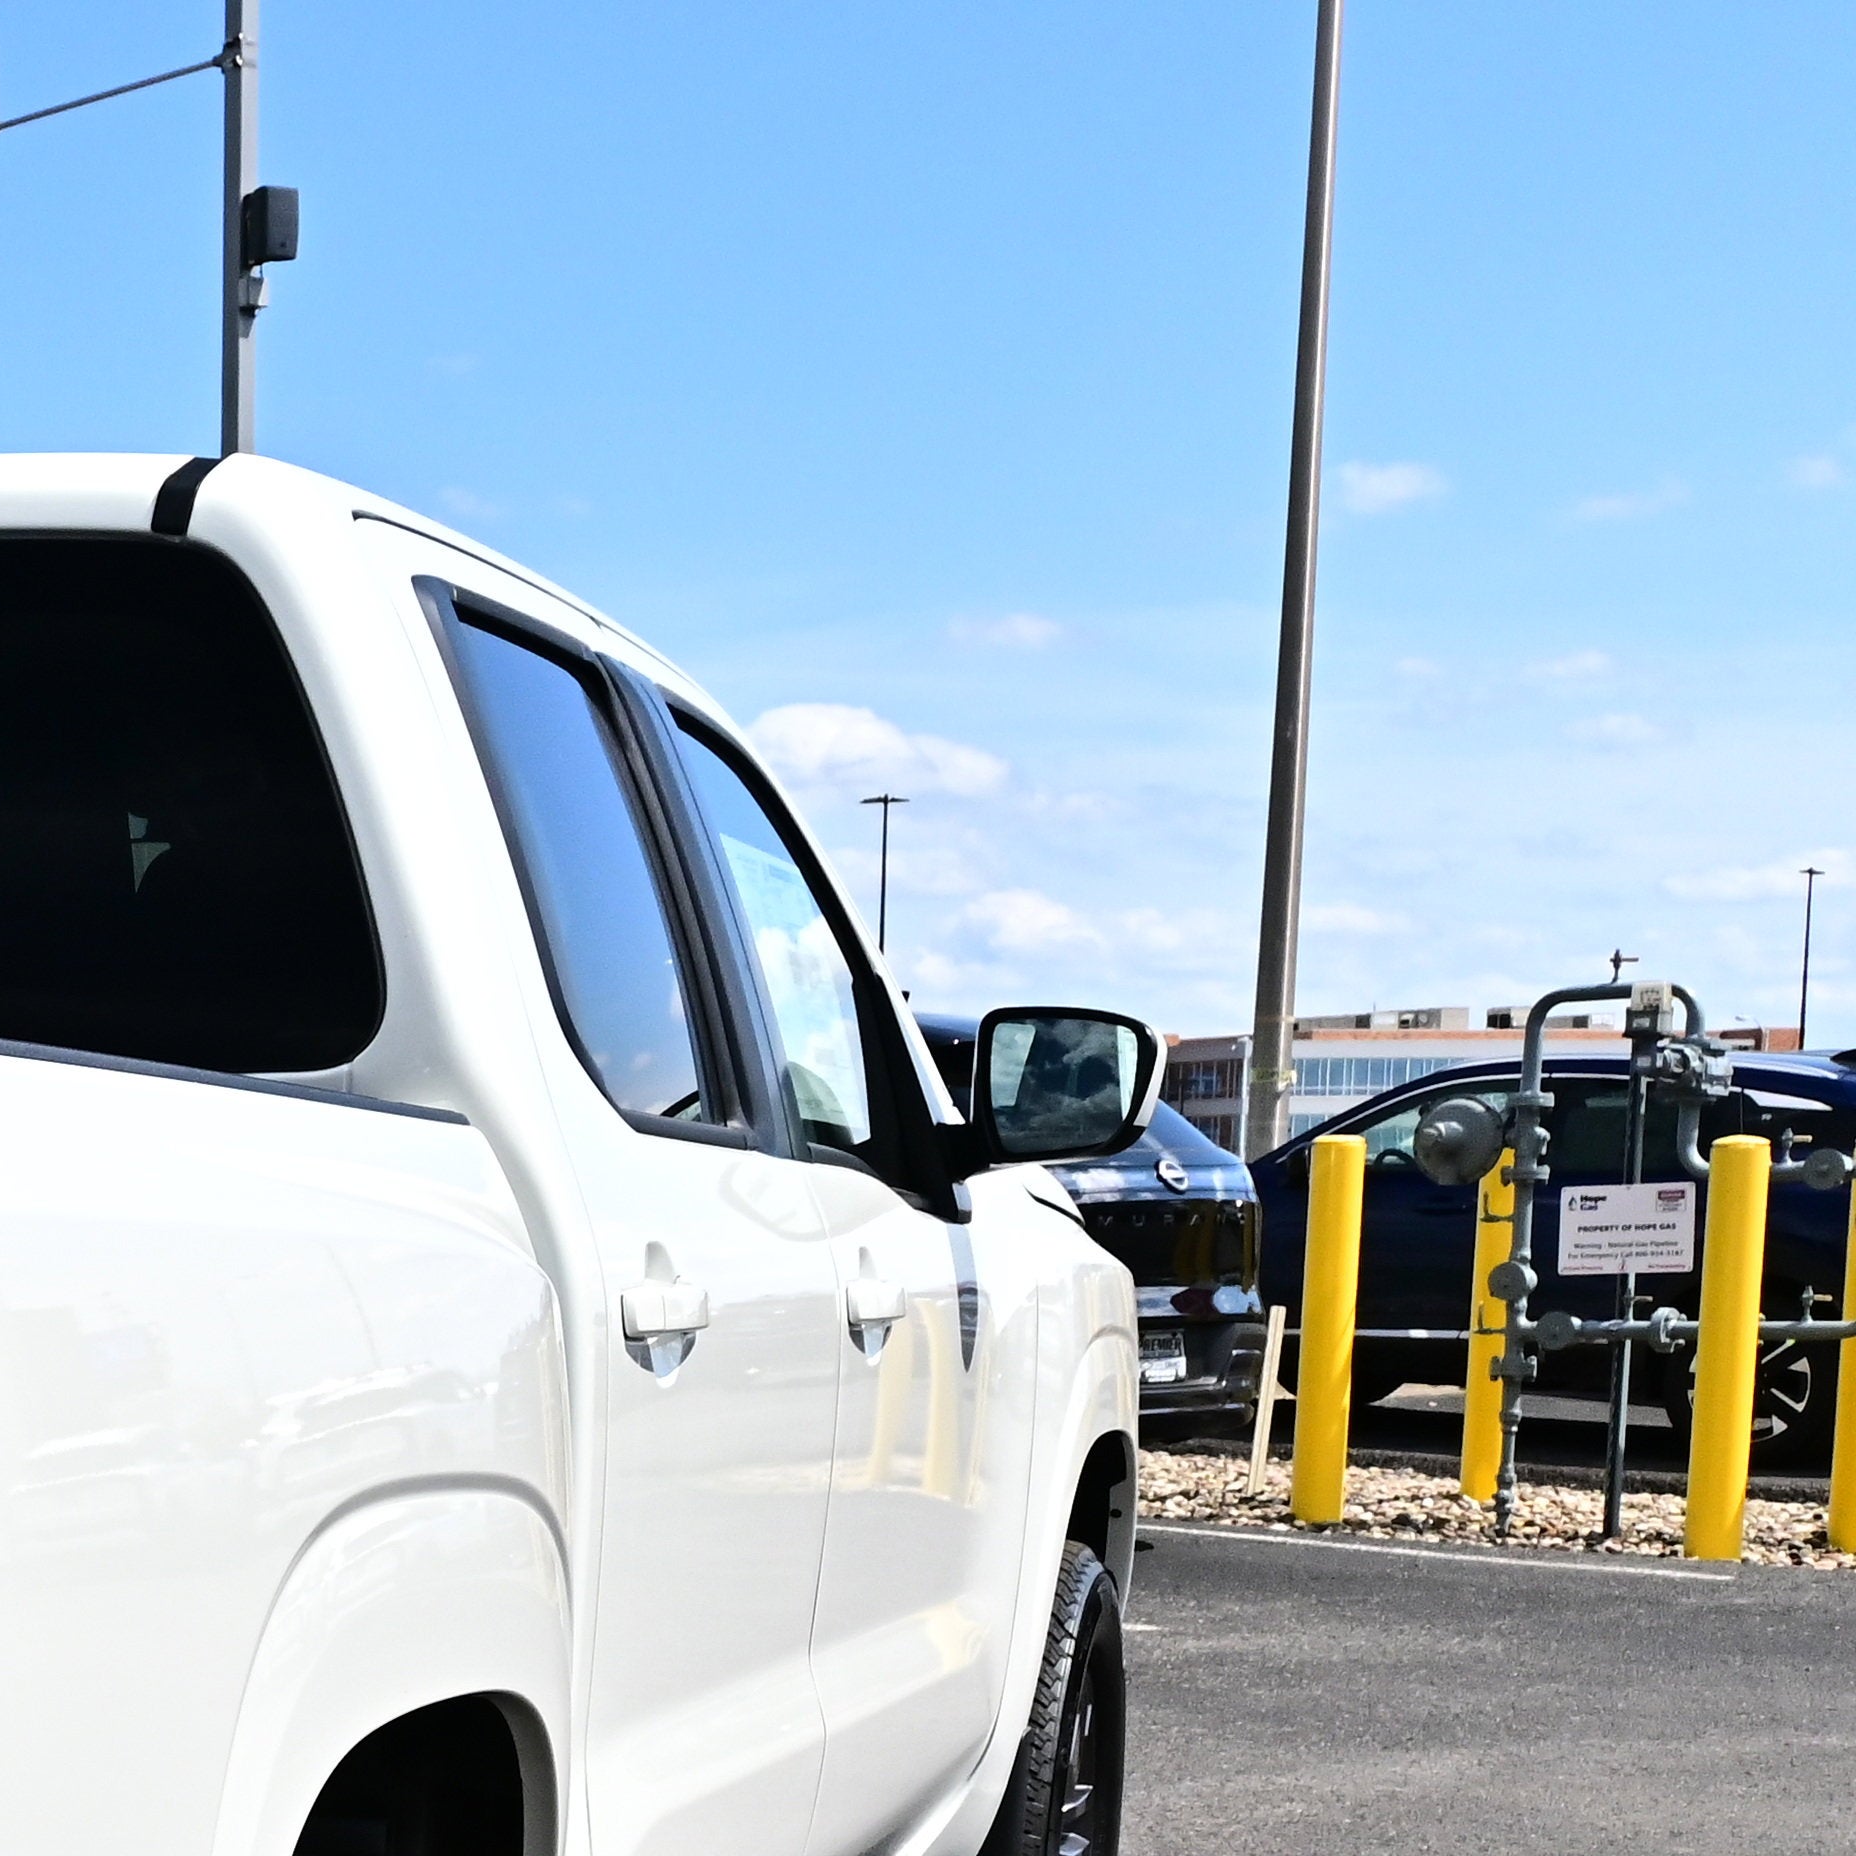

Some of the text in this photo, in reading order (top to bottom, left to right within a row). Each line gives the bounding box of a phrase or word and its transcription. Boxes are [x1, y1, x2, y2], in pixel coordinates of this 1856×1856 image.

[1577, 1222, 1676, 1233] PROPERTY OF HOPE GAS
